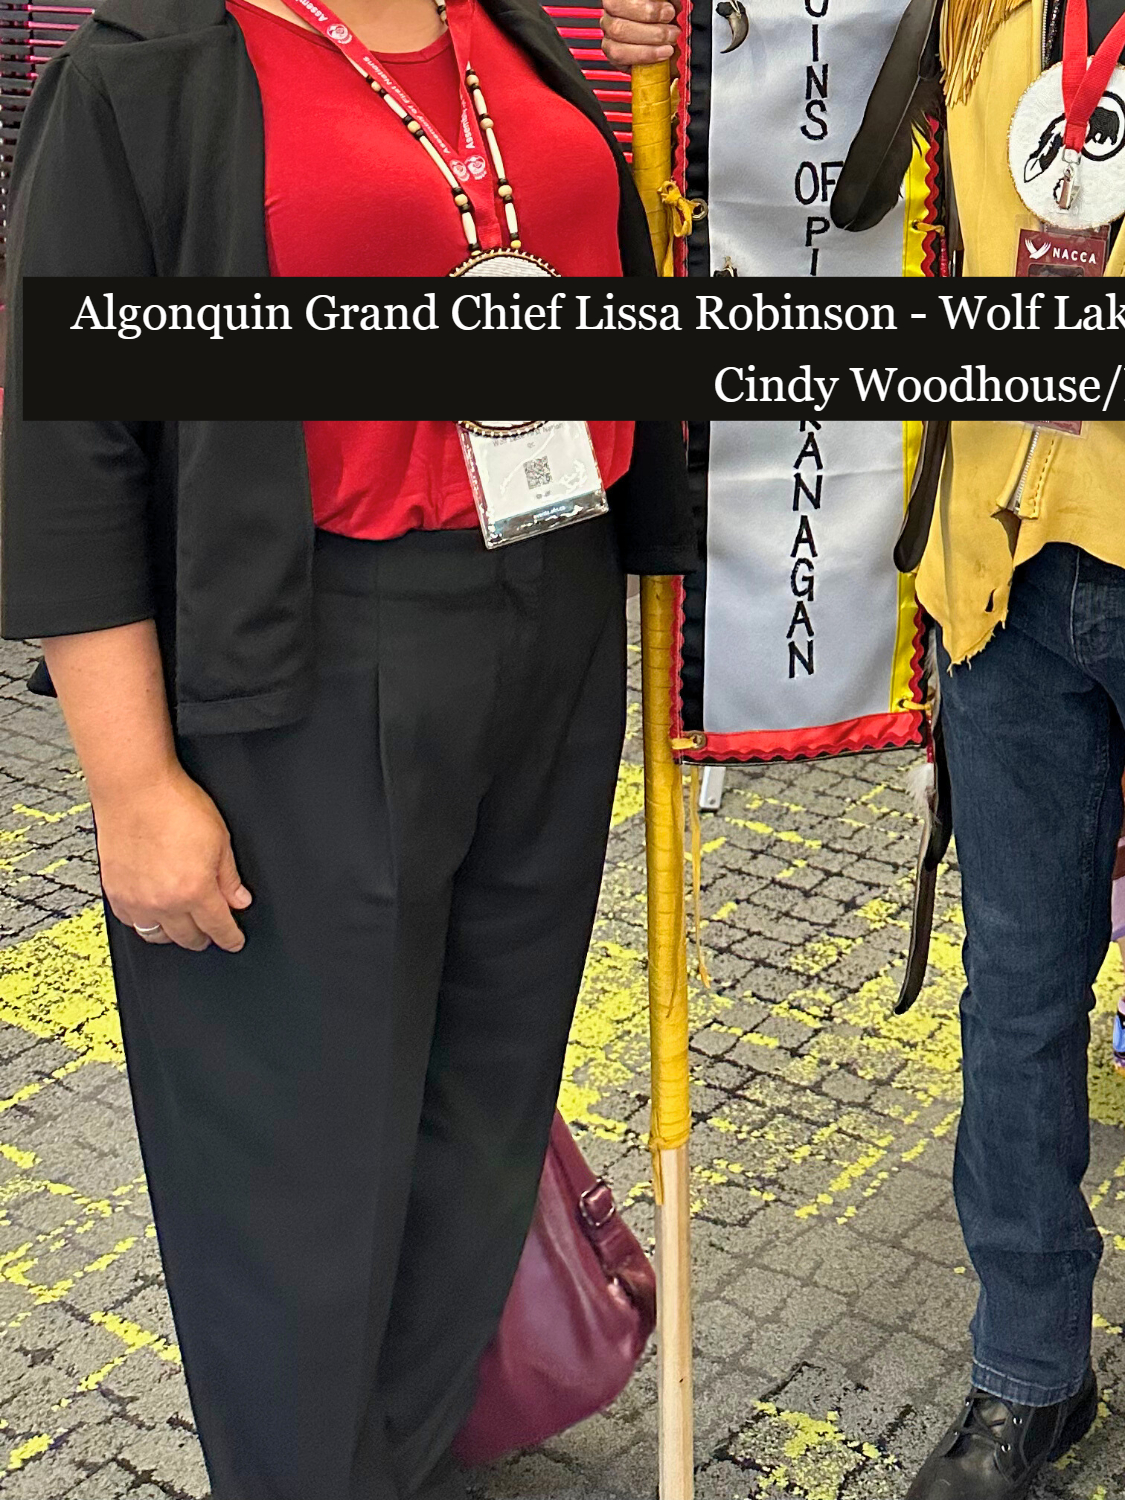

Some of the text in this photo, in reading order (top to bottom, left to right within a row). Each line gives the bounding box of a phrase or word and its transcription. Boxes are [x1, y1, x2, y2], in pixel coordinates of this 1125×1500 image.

[363, 56, 393, 85] Nations
[795, 161, 844, 205] OF
[1052, 247, 1097, 265] NACCA
